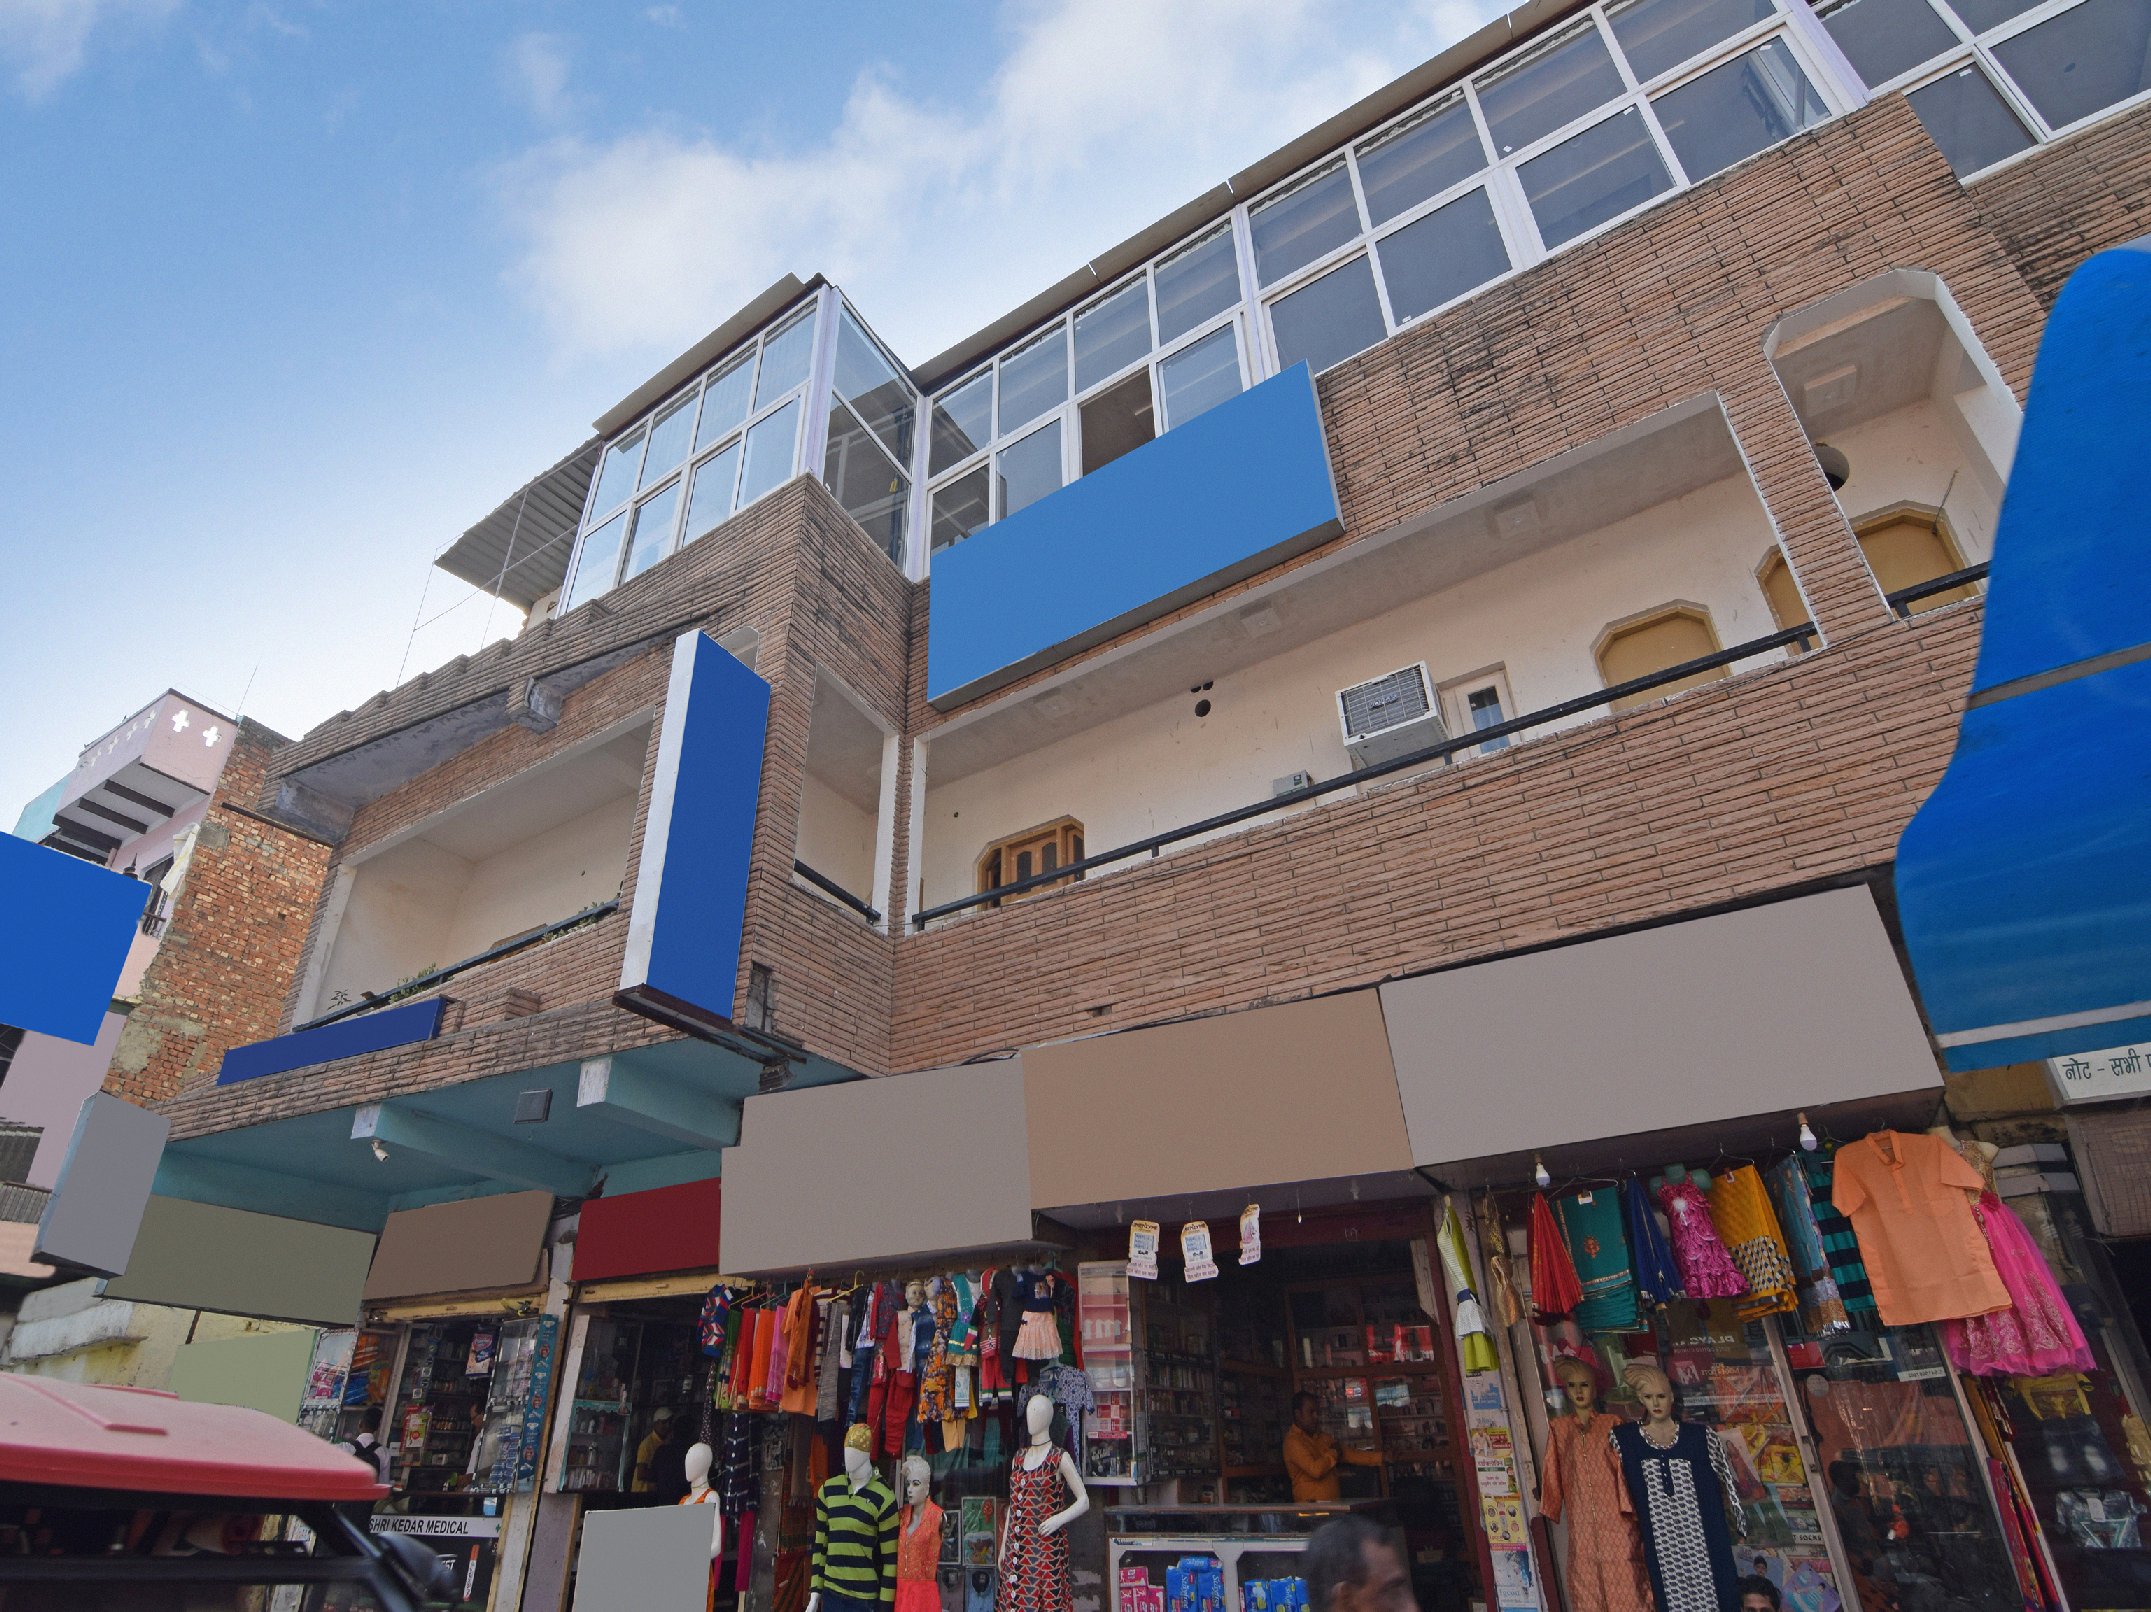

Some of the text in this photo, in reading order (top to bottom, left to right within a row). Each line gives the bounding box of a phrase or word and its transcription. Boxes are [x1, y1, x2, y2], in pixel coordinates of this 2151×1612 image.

[2062, 1058, 2092, 1080] नोट
[2108, 1048, 2141, 1077] सभी
[369, 1518, 468, 1534] SHRI KEDAR MEDICAL
